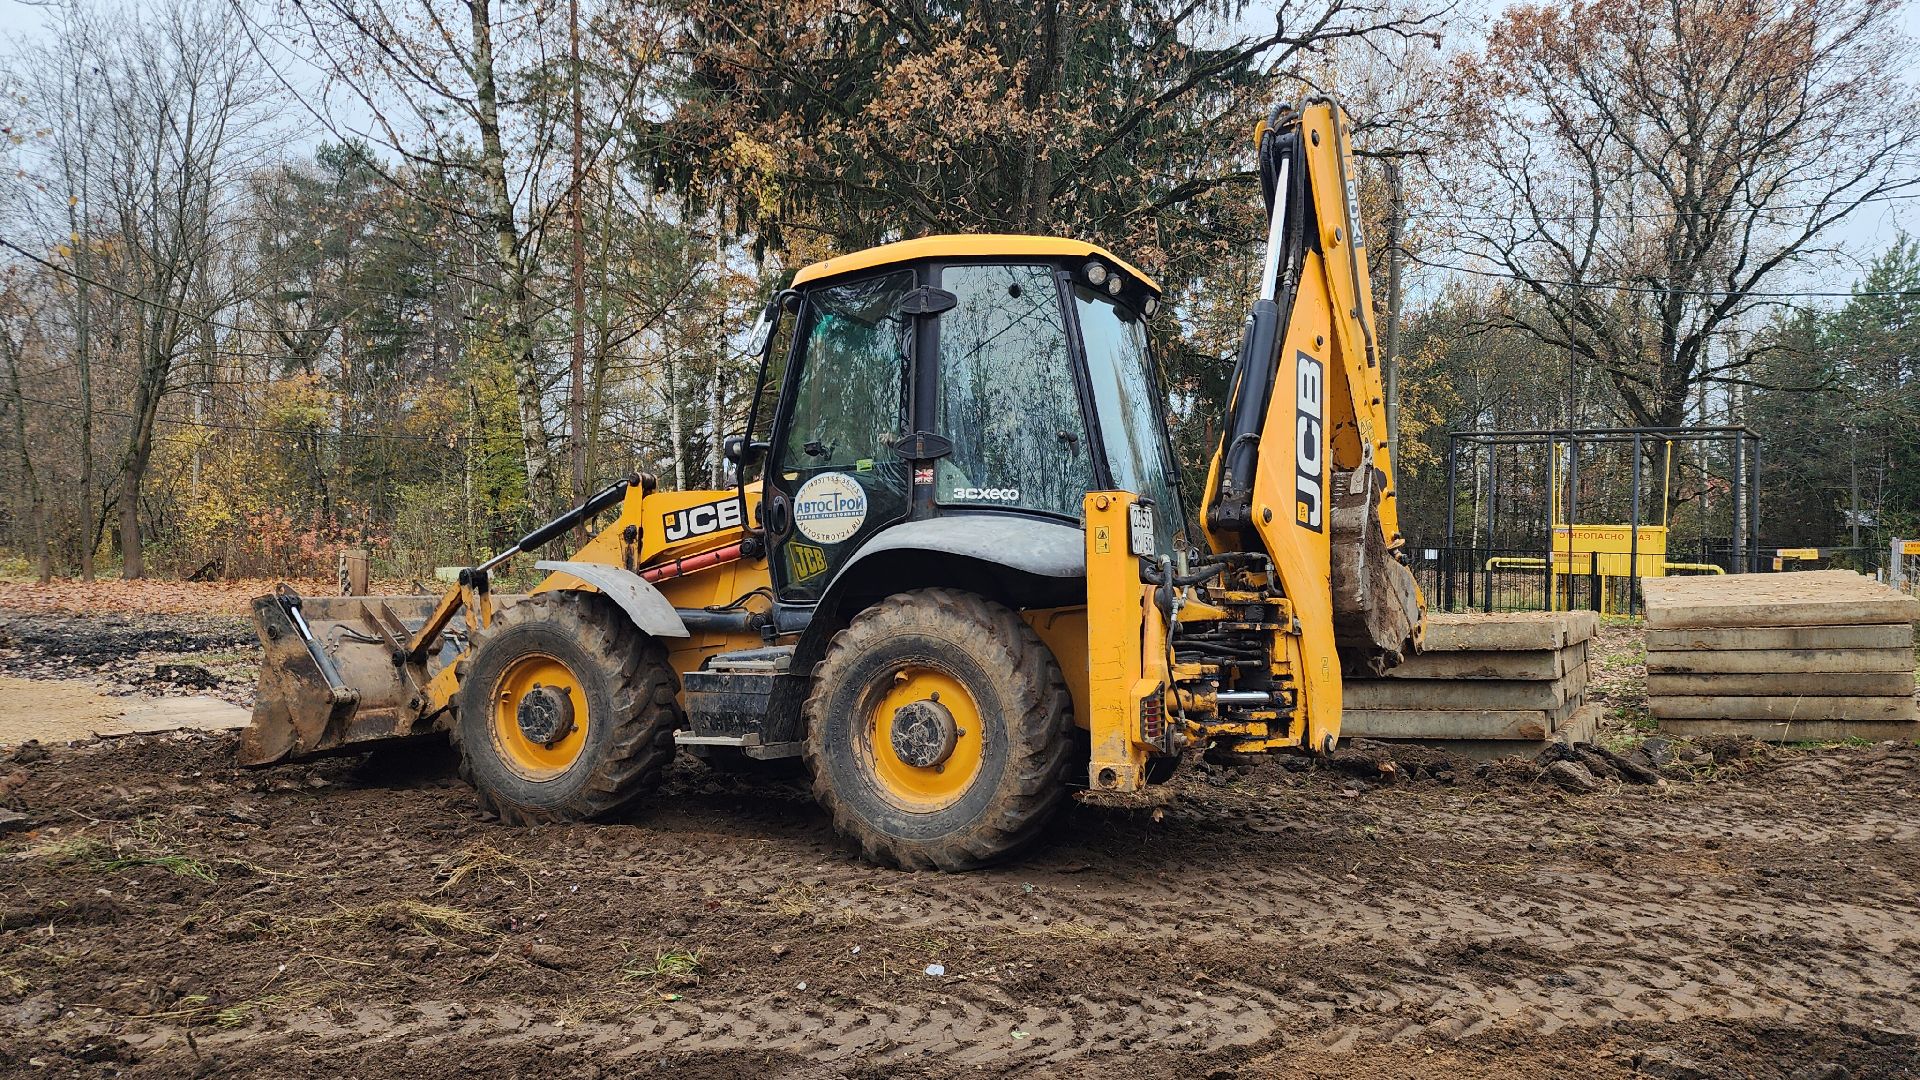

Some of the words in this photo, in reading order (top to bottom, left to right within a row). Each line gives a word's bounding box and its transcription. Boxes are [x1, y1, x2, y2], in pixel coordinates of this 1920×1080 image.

[1297, 358, 1321, 527] JCB
[666, 499, 741, 541] JCB
[795, 546, 825, 577] JCB
